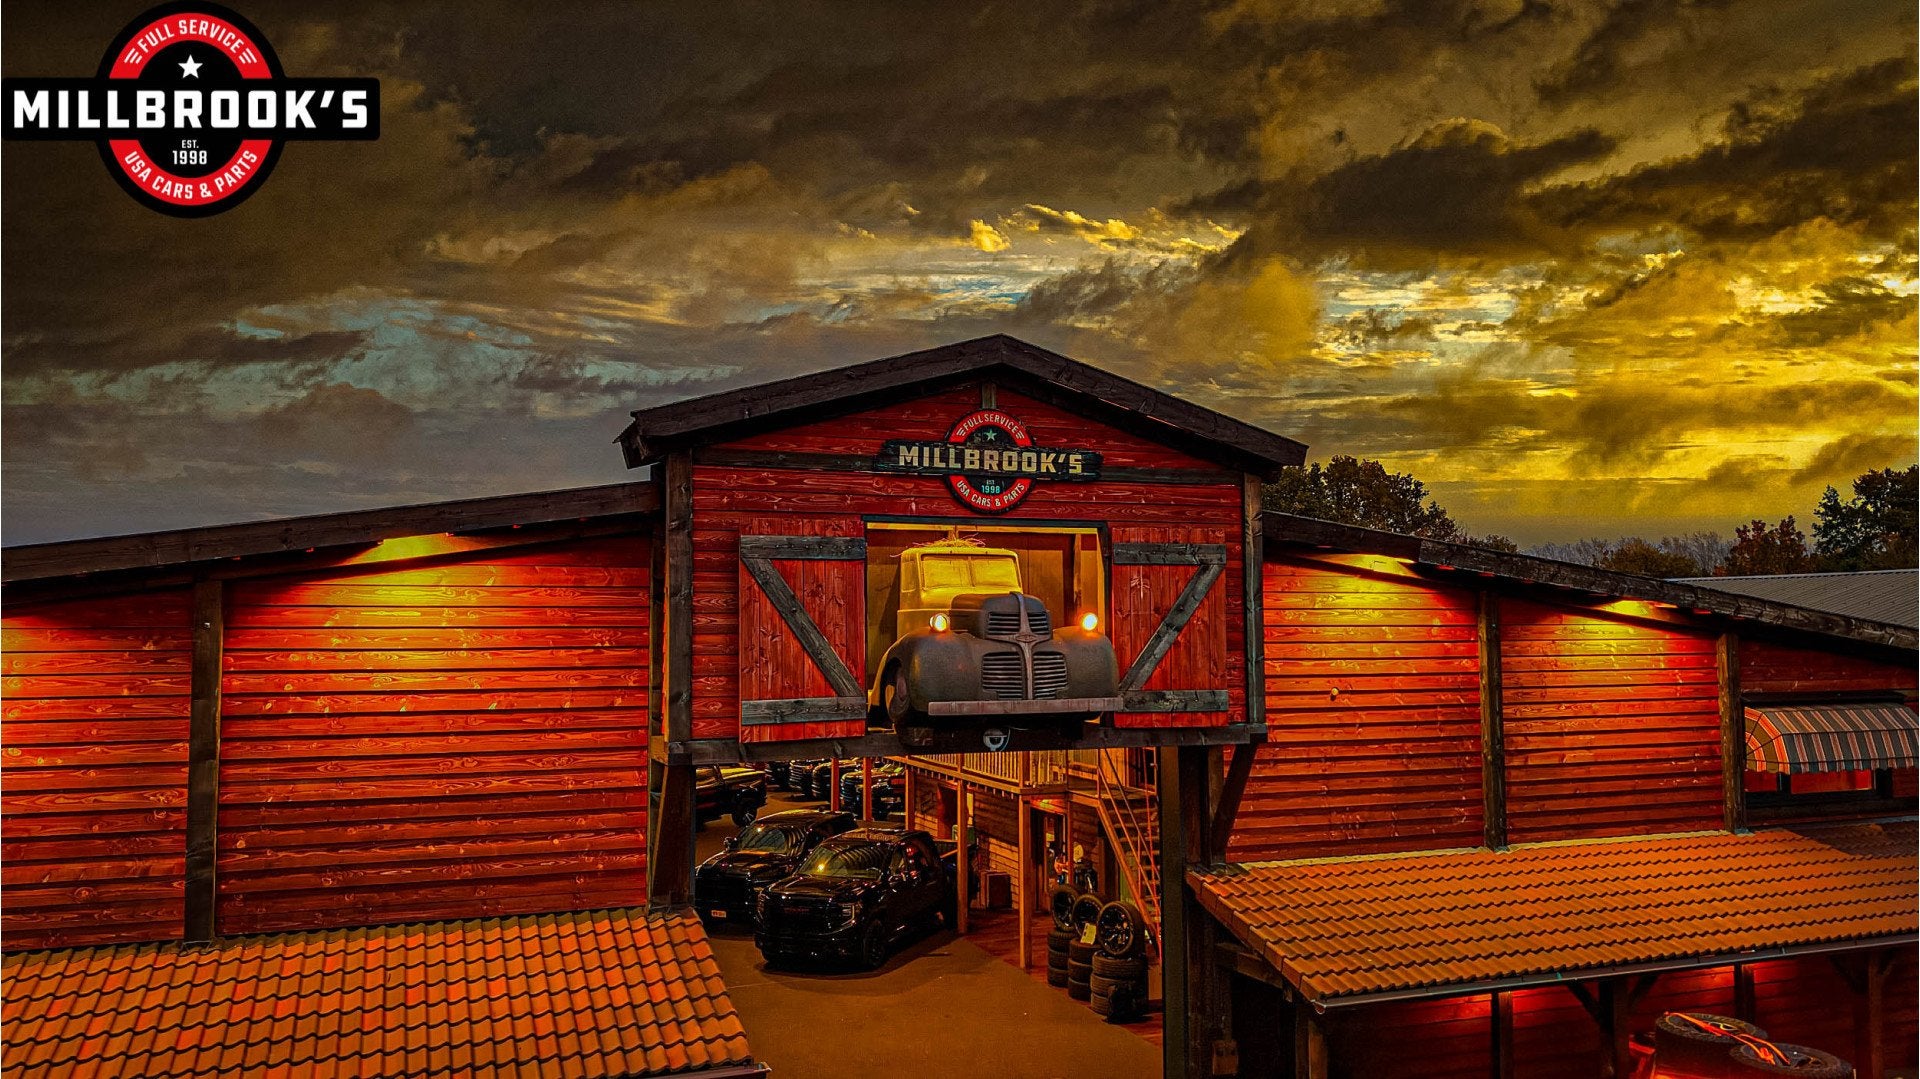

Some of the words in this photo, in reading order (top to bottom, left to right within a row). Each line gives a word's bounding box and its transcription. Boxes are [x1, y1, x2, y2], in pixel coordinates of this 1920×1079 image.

[964, 416, 983, 430] FULL
[984, 414, 1018, 434] SERVICE
[899, 445, 1083, 474] MILLBROOK'S
[956, 480, 970, 498] USA
[971, 494, 991, 508] CARS
[995, 498, 1001, 507] &
[1003, 483, 1025, 504] PARTS
[981, 485, 1000, 494] 1998
